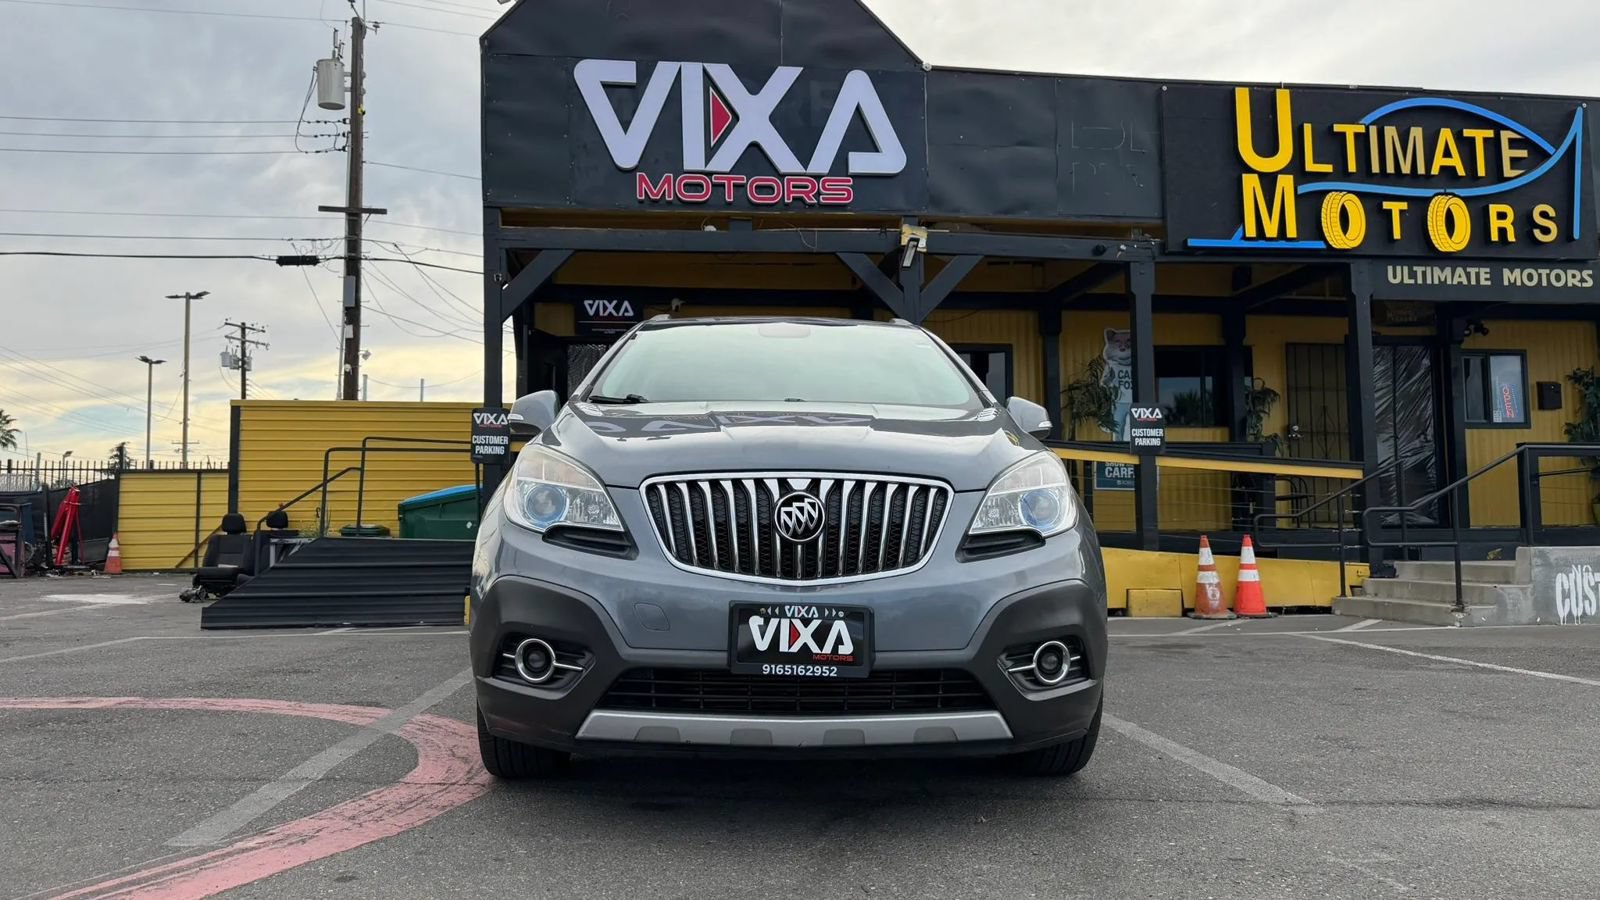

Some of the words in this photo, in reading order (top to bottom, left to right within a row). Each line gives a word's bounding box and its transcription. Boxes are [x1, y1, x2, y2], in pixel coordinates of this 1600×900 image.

[573, 58, 907, 176] VIXA
[1235, 87, 1528, 178] ULTIMATE
[636, 172, 854, 204] MOTORS
[1241, 173, 1559, 253] MOTORS
[1387, 265, 1492, 286] ULTIMATE
[1502, 267, 1594, 288] MOTORS
[583, 299, 635, 317] VIXA
[1117, 369, 1131, 380] CA
[1118, 380, 1132, 390] FO
[472, 412, 509, 425] VIXA
[1130, 407, 1163, 418] VIXA
[1131, 428, 1164, 437] CUSTOMER
[471, 435, 509, 445] CUSTOMER
[1134, 437, 1161, 446] PARKING
[475, 445, 505, 455] PARKING
[1104, 466, 1135, 478] CARF
[784, 605, 819, 618] VIXA
[748, 615, 854, 654] VIXA
[812, 654, 854, 662] MOTORS
[762, 664, 838, 677] 9165162952
